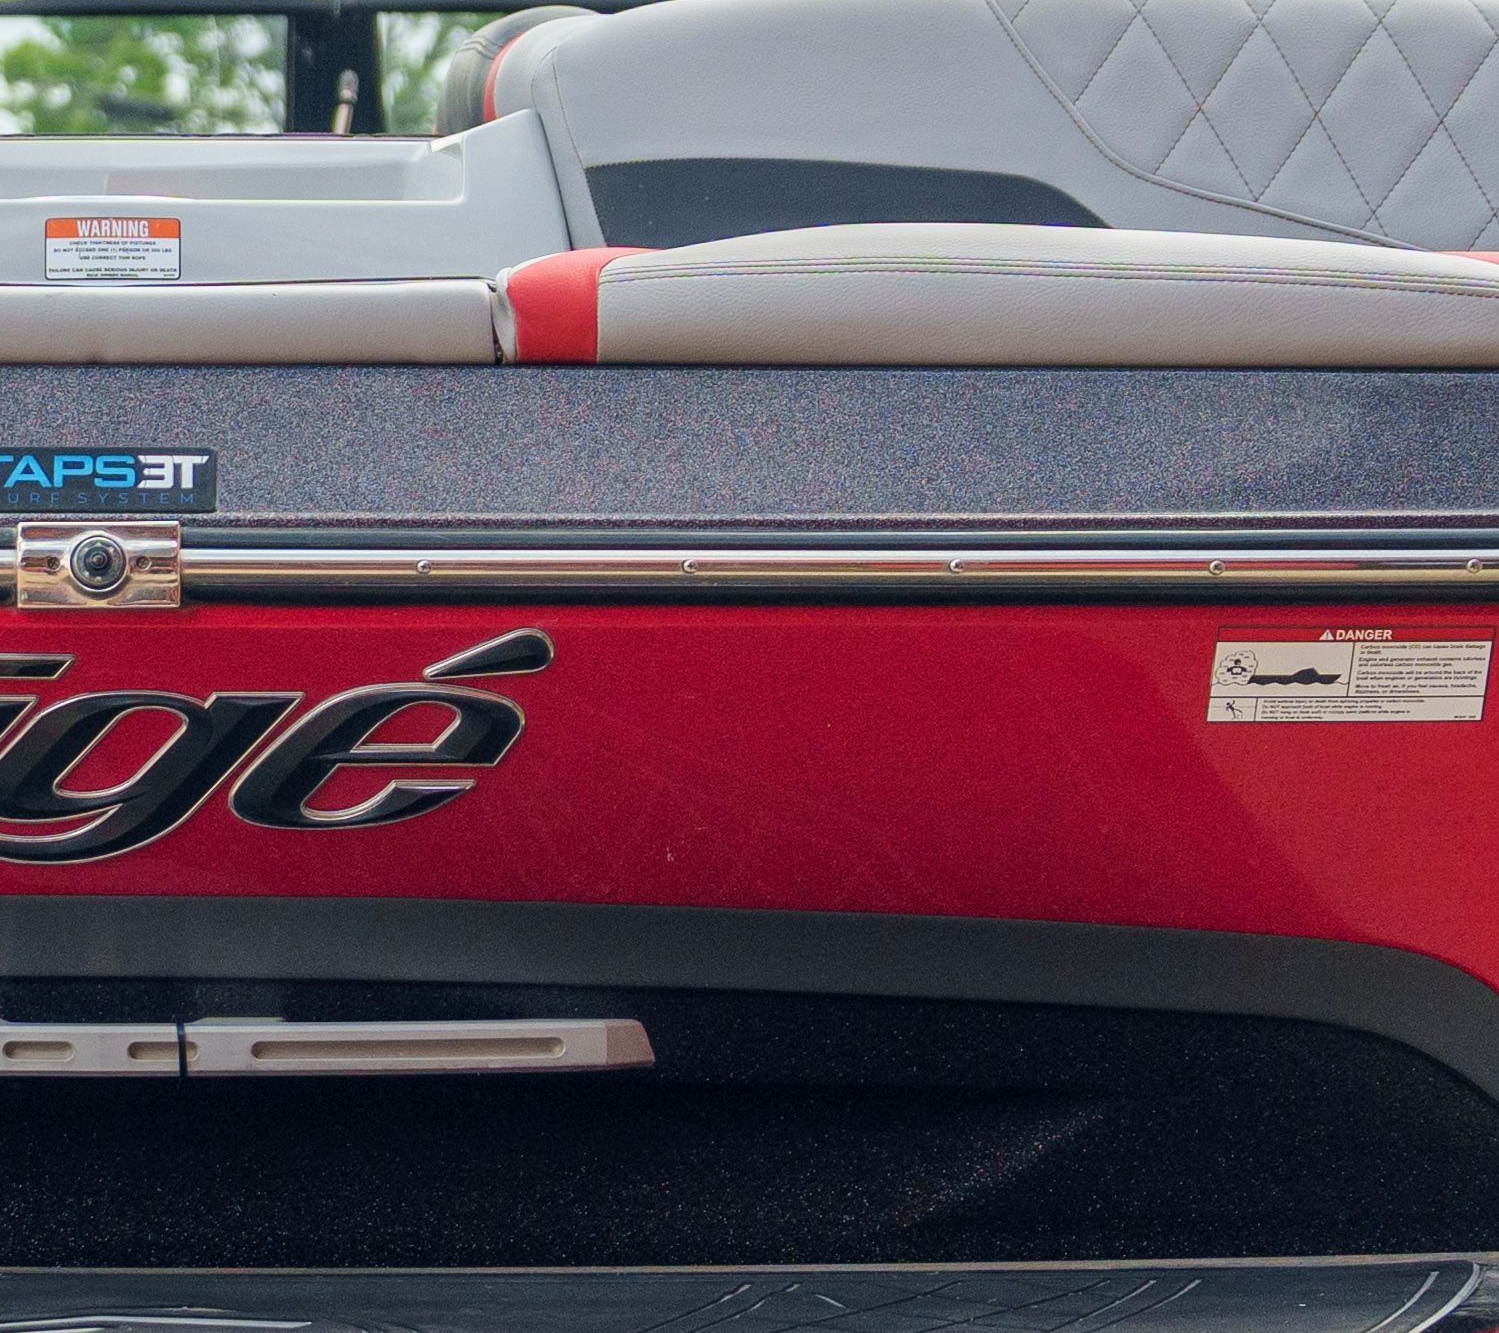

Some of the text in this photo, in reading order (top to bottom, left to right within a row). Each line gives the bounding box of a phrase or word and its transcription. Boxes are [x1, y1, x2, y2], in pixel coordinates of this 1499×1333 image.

[77, 220, 149, 237] WARNING
[78, 492, 195, 504] SYSTEM
[1335, 629, 1393, 640] DANGER
